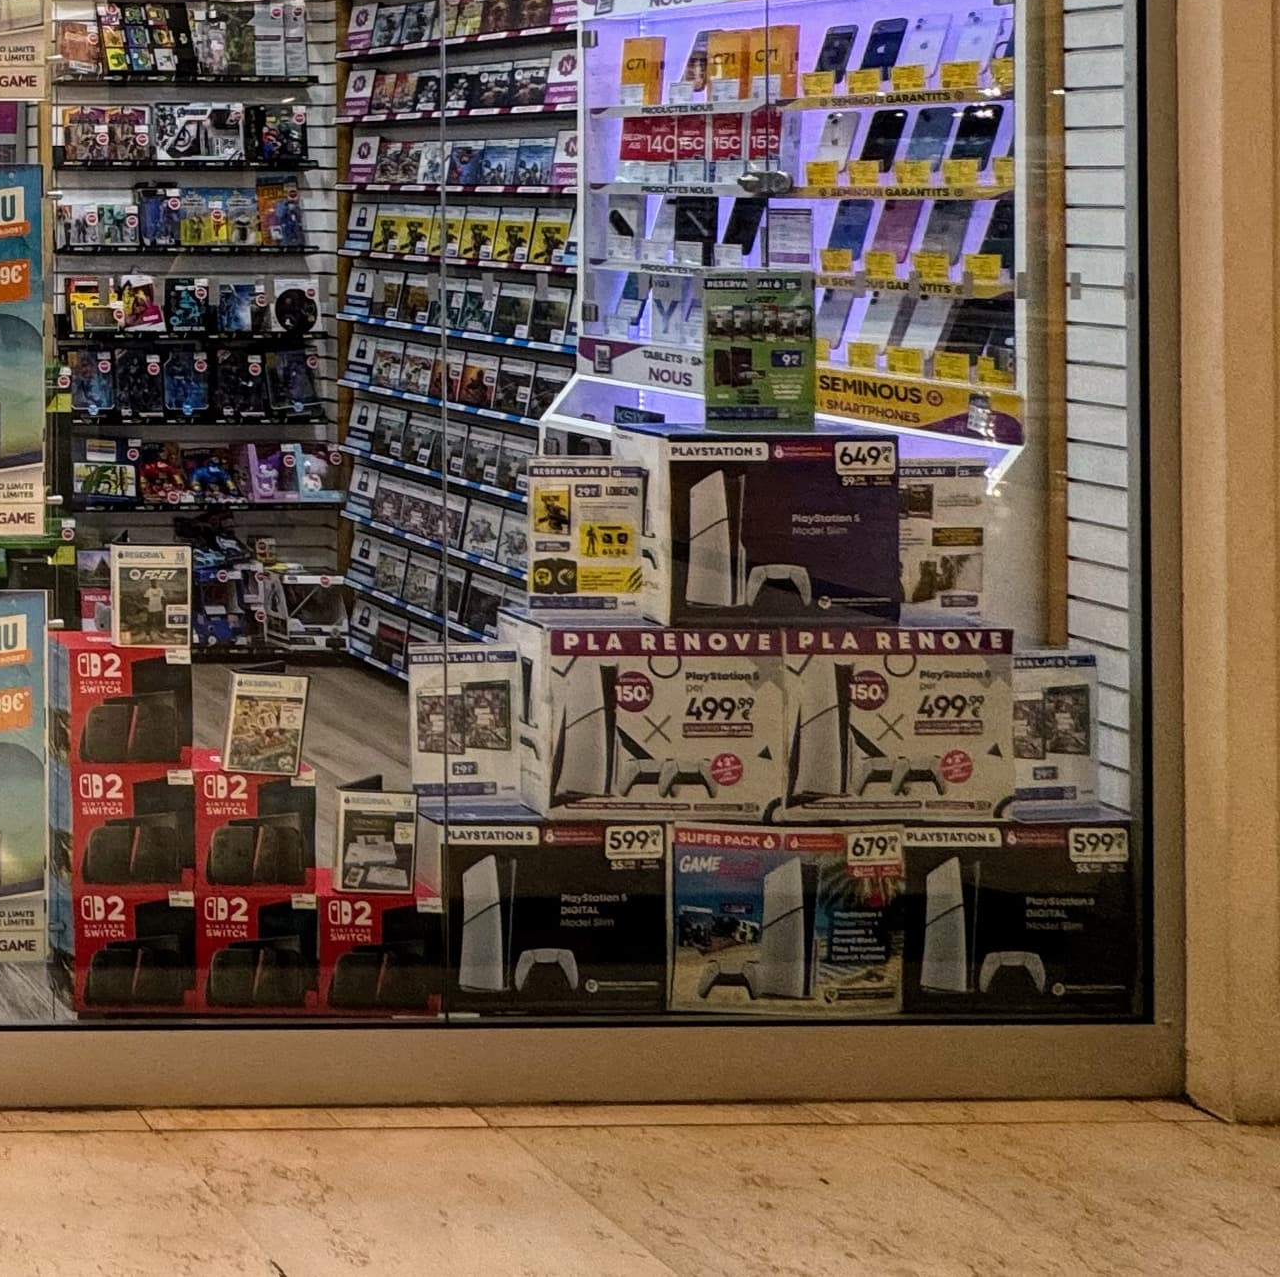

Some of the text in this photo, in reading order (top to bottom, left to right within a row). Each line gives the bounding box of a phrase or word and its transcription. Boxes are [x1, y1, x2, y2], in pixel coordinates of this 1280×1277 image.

[0, 74, 38, 88] GAME
[886, 92, 951, 104] GARANTITS
[641, 103, 714, 114] PRODUCTES NOUS
[648, 367, 693, 387] NOUS
[818, 376, 923, 405] SEMINOUS
[826, 399, 921, 424] SMARTPHONES
[671, 445, 763, 459] PLAYSTATION 5
[563, 632, 771, 651] PLA RENOVE
[798, 631, 1003, 650] PLA RENOVE
[79, 685, 122, 694] SWITCH
[82, 806, 123, 815] SWITCH
[205, 807, 248, 816] SWITCH
[526, 831, 533, 841] 5
[677, 831, 760, 847] SUPER PACK
[906, 832, 986, 843] PLAYSTATION
[679, 855, 722, 873] GAME
